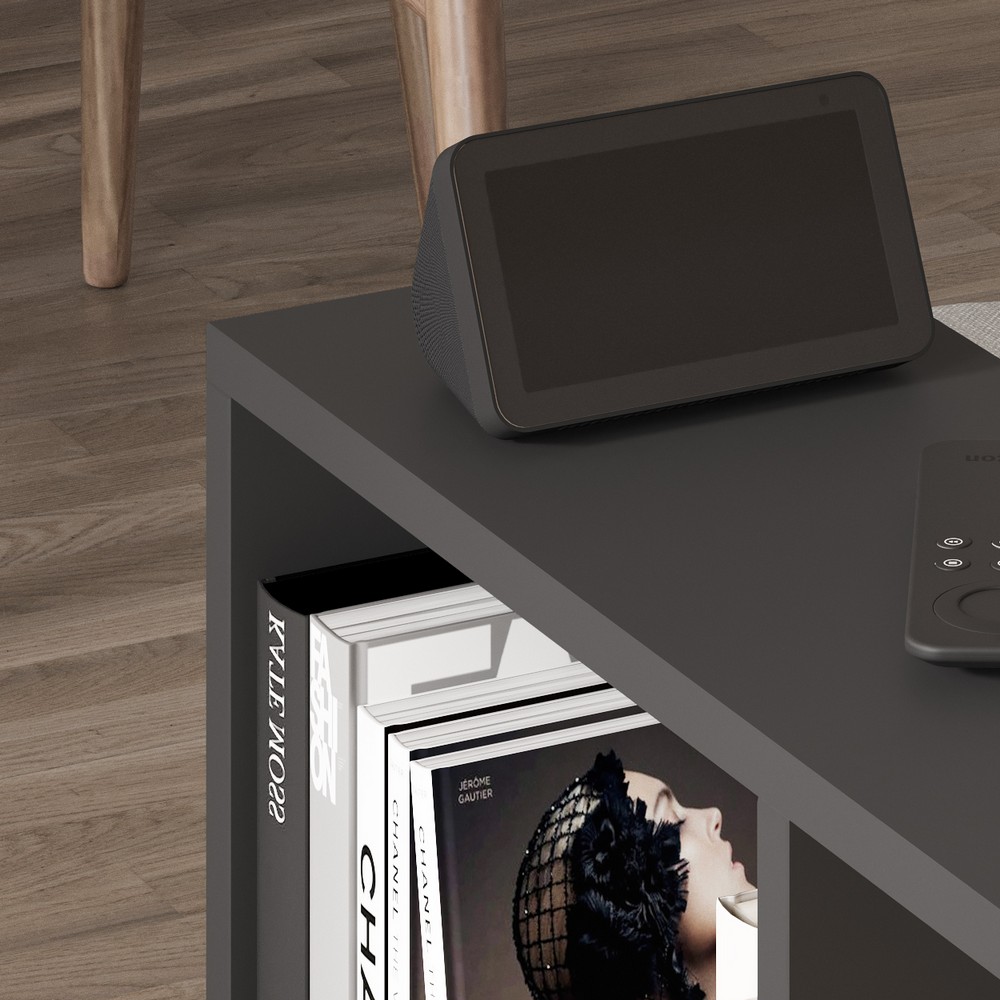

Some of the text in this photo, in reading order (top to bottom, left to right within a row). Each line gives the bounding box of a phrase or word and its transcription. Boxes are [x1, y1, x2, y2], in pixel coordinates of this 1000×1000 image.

[459, 776, 491, 791] JÉRÔME
[458, 788, 493, 804] GAUTIER
[418, 826, 432, 953] CHANEL
